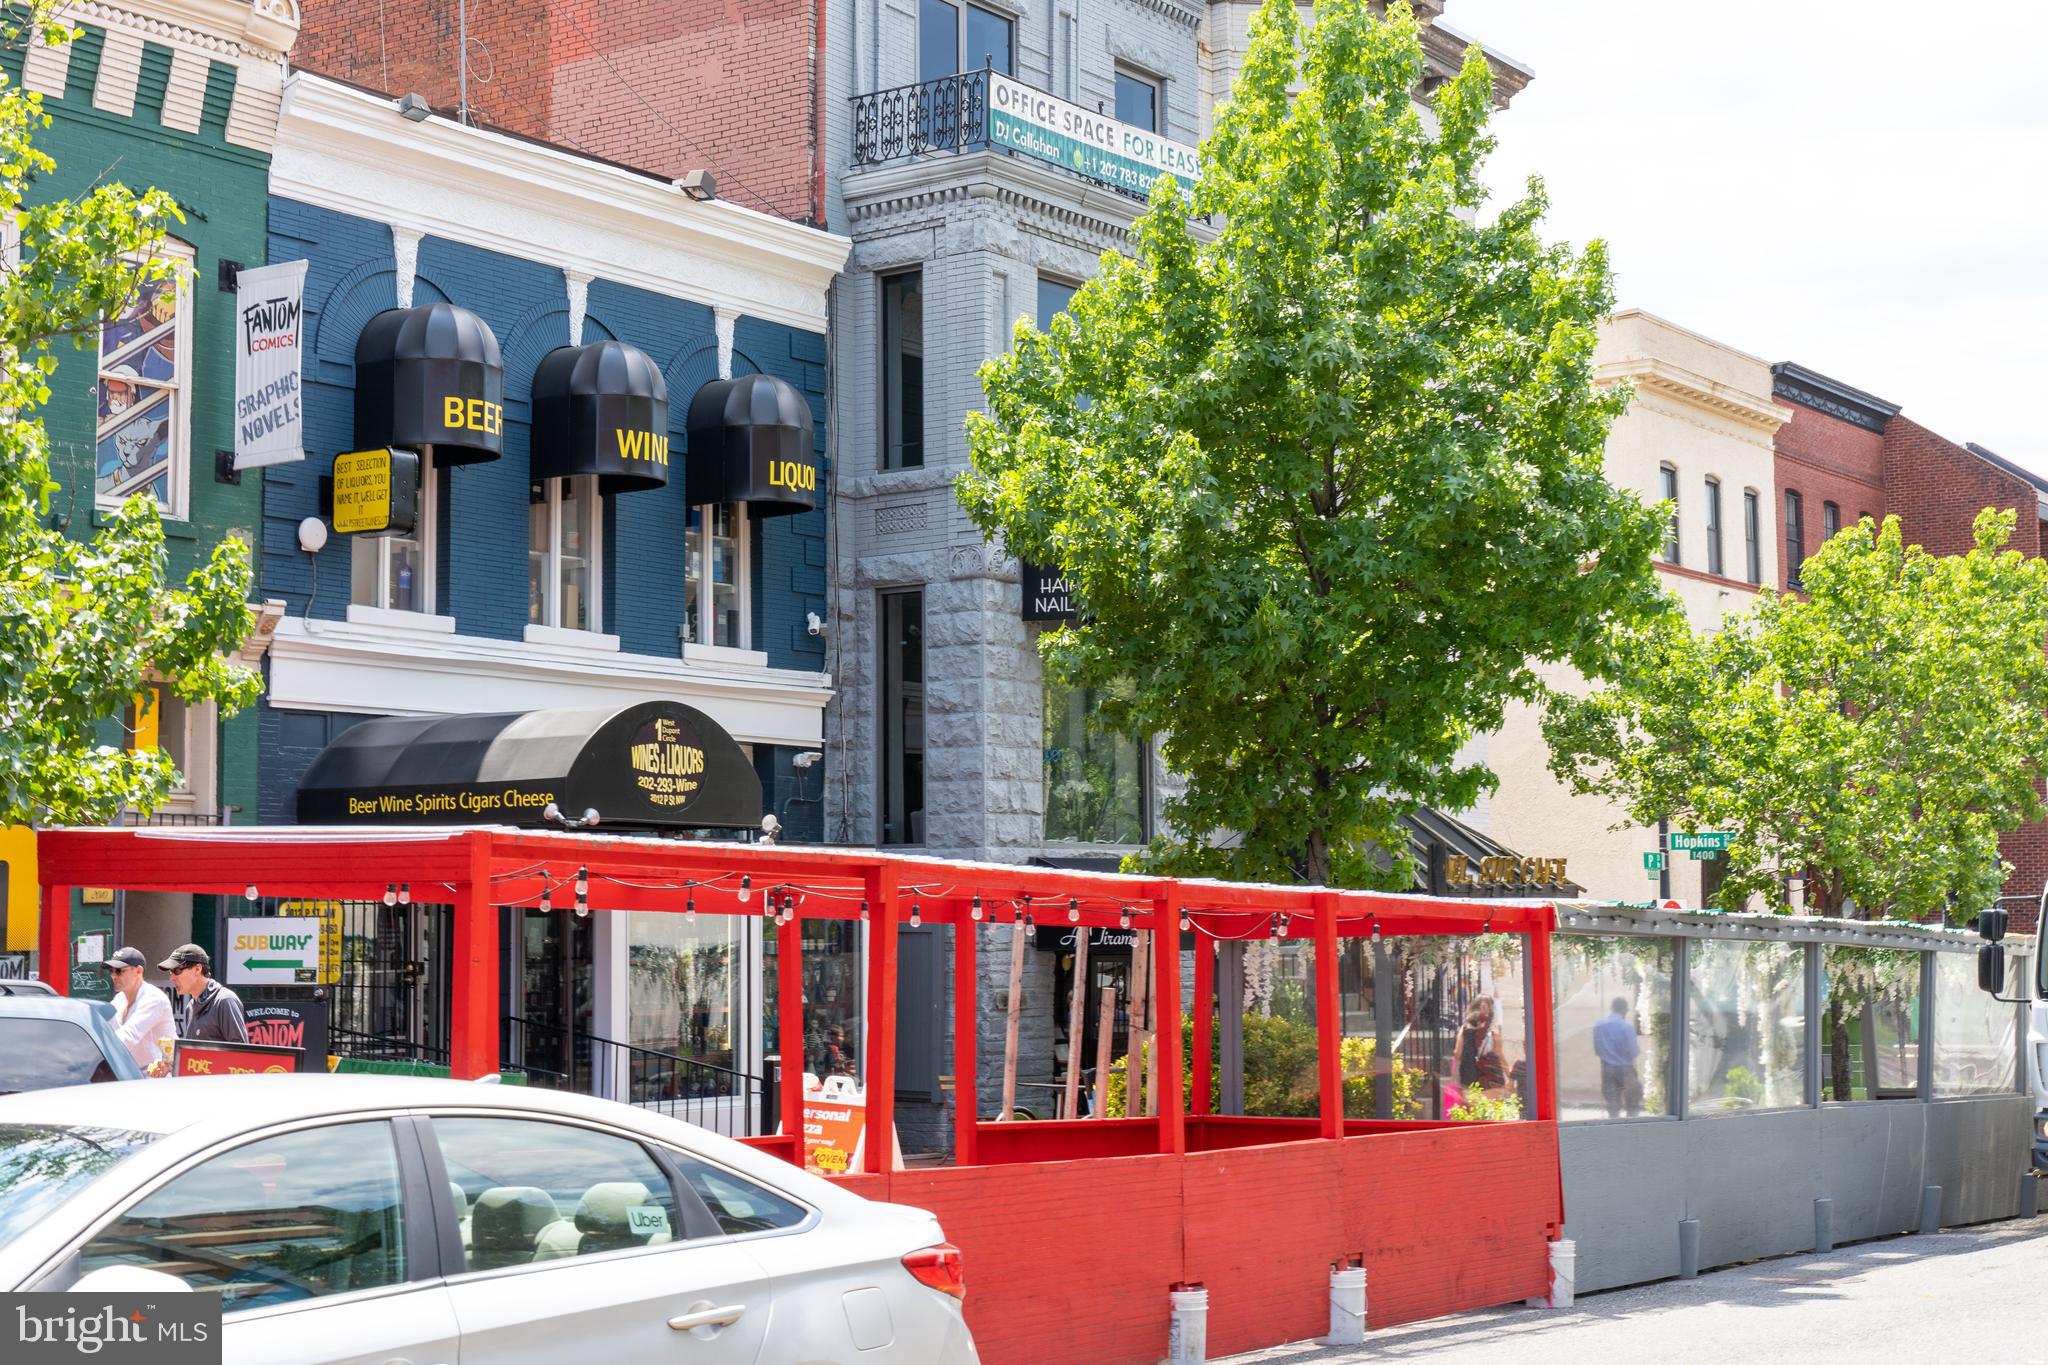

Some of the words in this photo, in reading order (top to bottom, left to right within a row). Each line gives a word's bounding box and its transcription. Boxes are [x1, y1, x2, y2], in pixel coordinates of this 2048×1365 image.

[996, 84, 1056, 126] OFFICE
[1063, 110, 1115, 147] SPACE
[1123, 132, 1154, 162] FOR
[996, 121, 1009, 140] DJ
[1012, 128, 1060, 157] Callahan
[1100, 160, 1117, 179] 202
[1119, 166, 1138, 185] 783
[243, 296, 301, 357] FANTOM
[252, 334, 294, 353] COMICS
[237, 370, 299, 420] GRAPHIC
[616, 428, 669, 466] WINE
[336, 461, 352, 474] BEST
[356, 457, 387, 471] SELECTION
[336, 478, 344, 490] OF
[374, 473, 387, 484] YOU
[769, 460, 815, 492] LIQUO
[336, 493, 353, 505] NAME
[376, 488, 388, 500] GET
[358, 504, 364, 515] IT
[655, 718, 663, 741] 1
[662, 719, 676, 727] West
[662, 726, 680, 735] Dupont
[662, 735, 677, 743] Circle
[631, 743, 660, 774] WINES
[666, 743, 704, 777] LIQUORS
[637, 776, 698, 793] 202-293-Wine
[349, 797, 378, 815] Beer
[379, 795, 413, 812] Wine
[415, 793, 457, 815] Spirits
[459, 791, 501, 813] Cigars
[503, 789, 554, 807] Cheese
[650, 793, 664, 805] 2012
[663, 795, 669, 806] P
[669, 794, 676, 806] St
[675, 795, 686, 805] NW
[1674, 834, 1721, 850] Hopkins
[1648, 854, 1654, 868] P
[1692, 850, 1715, 860] 1400
[233, 933, 313, 952] SUBWAY
[245, 1007, 290, 1018] WELCOME
[290, 1010, 300, 1018] to
[245, 1018, 305, 1049] FANTOM
[803, 1108, 851, 1123] ersonal
[803, 1123, 823, 1135] zza
[630, 1211, 663, 1228] Uber
